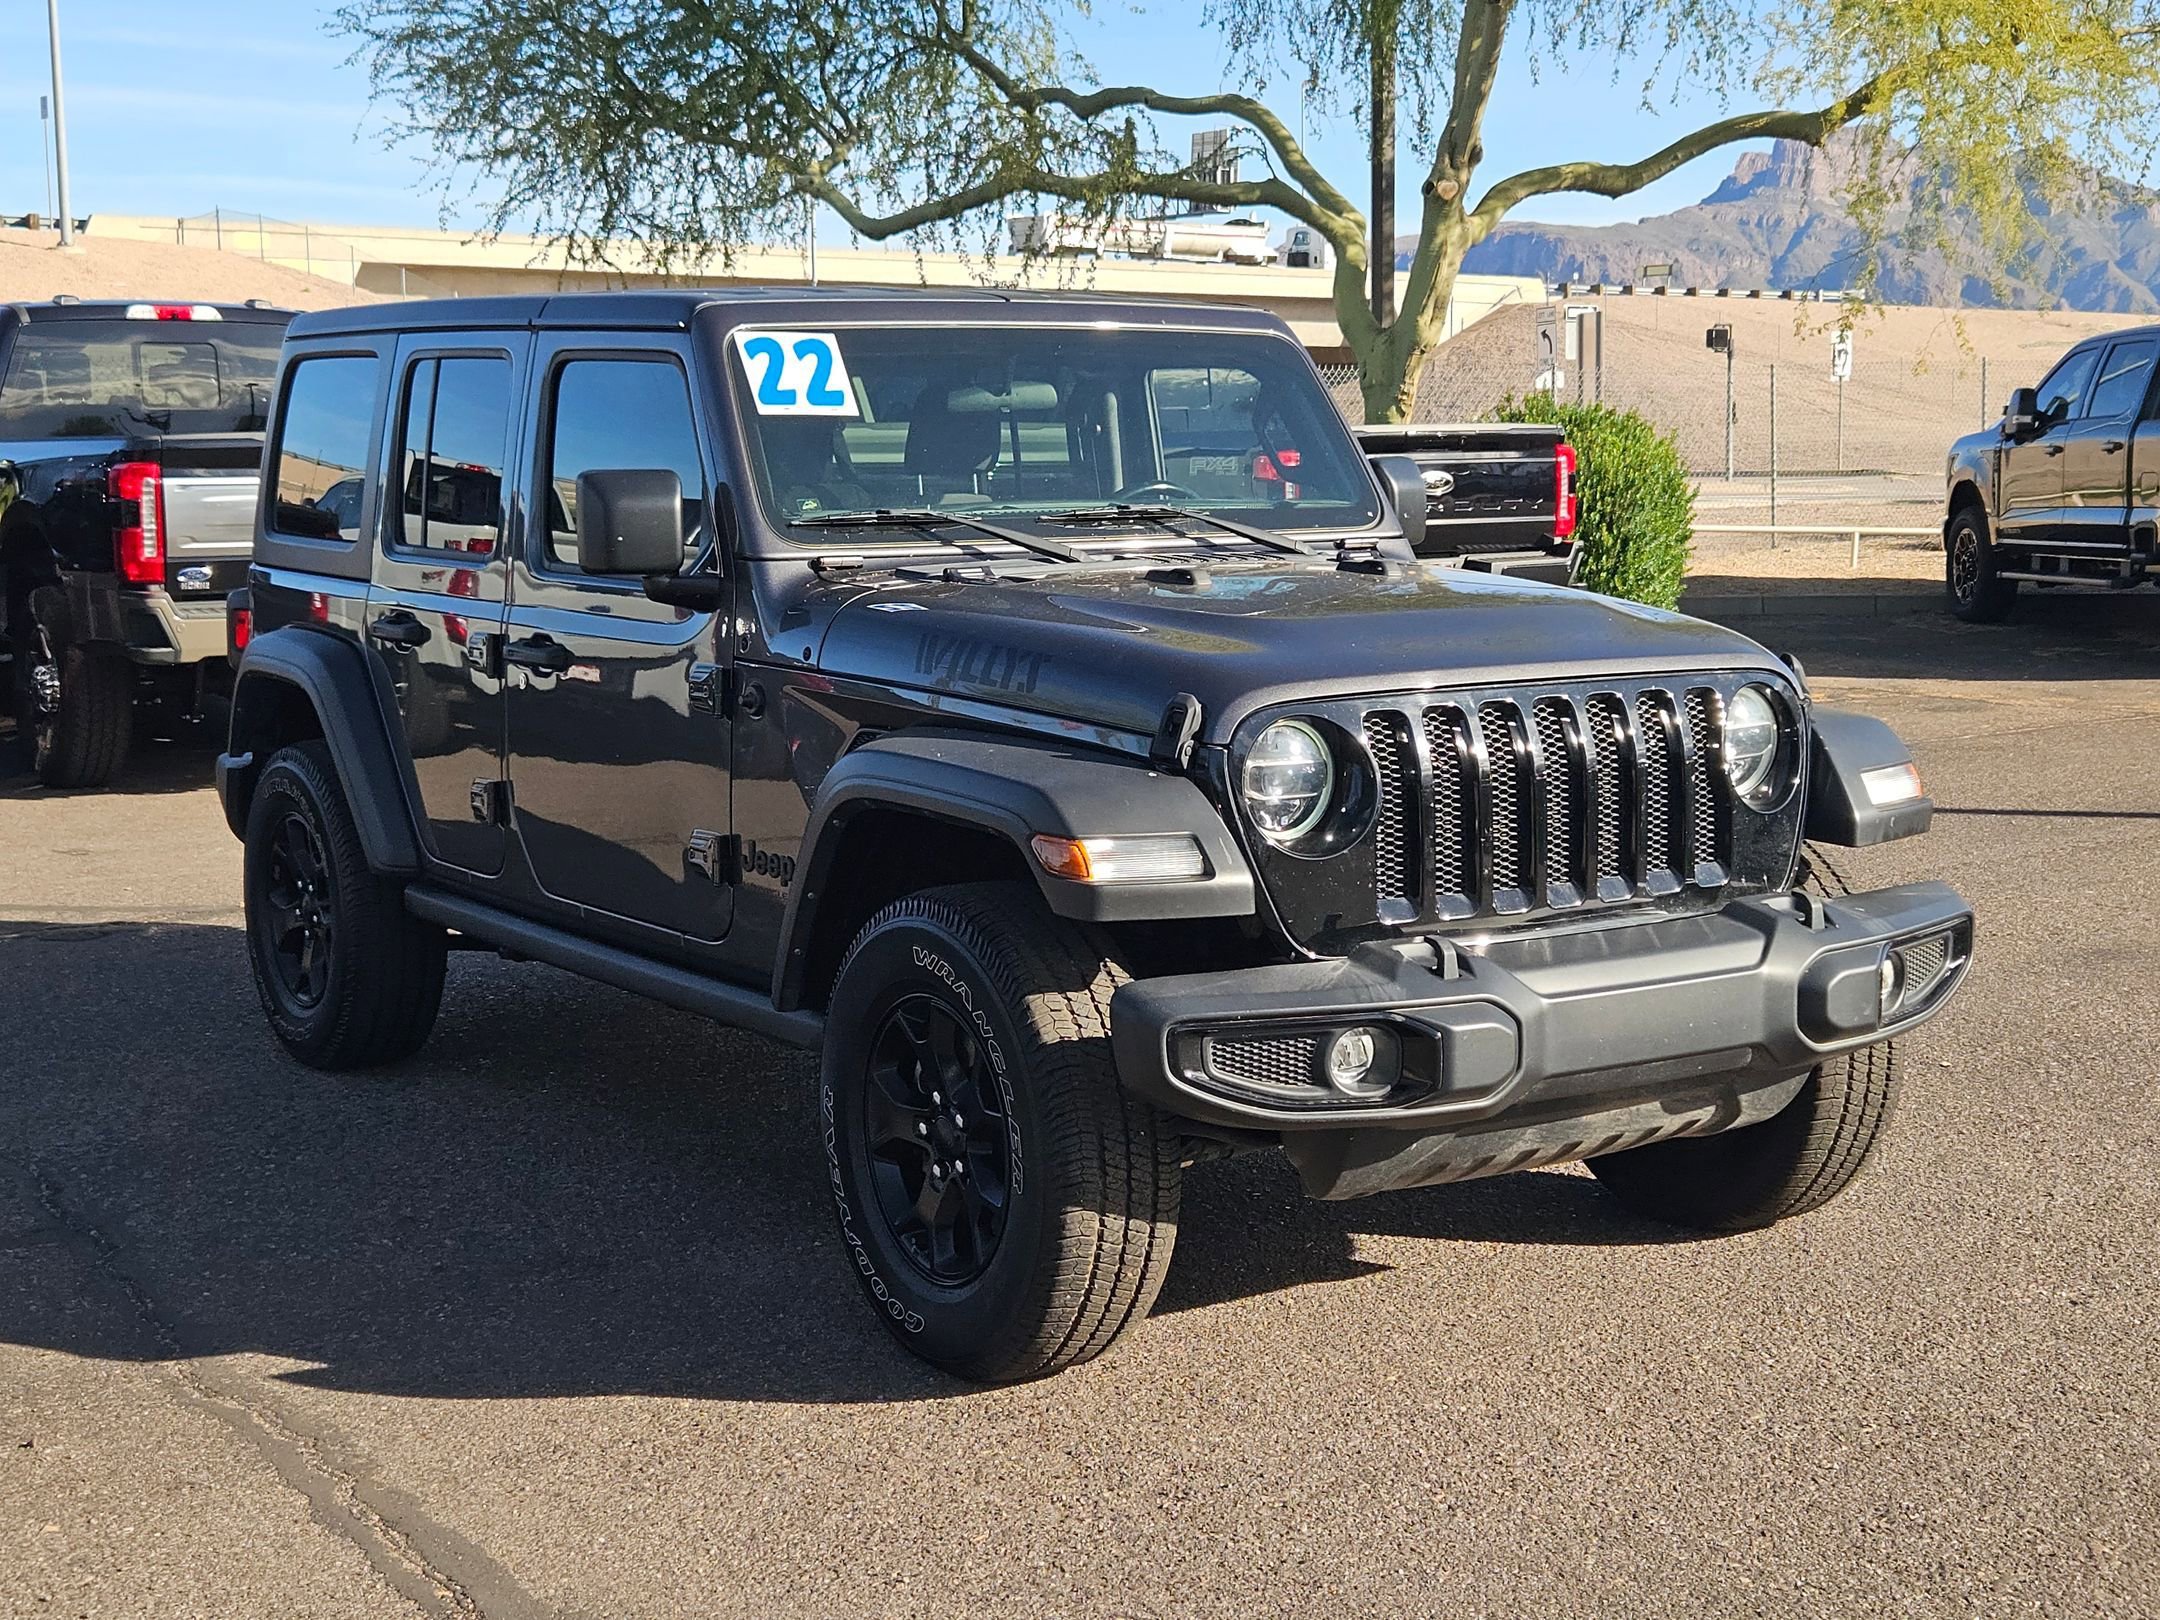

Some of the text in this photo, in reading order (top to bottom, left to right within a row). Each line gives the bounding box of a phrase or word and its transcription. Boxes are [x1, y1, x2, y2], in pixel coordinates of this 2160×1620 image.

[744, 337, 844, 406] 22
[1190, 456, 1238, 475] FX4
[914, 633, 1056, 694] WILLYS
[741, 839, 796, 887] Jeep
[912, 944, 1025, 1195] WRANGLER
[822, 1084, 926, 1334] GOODYEAR
